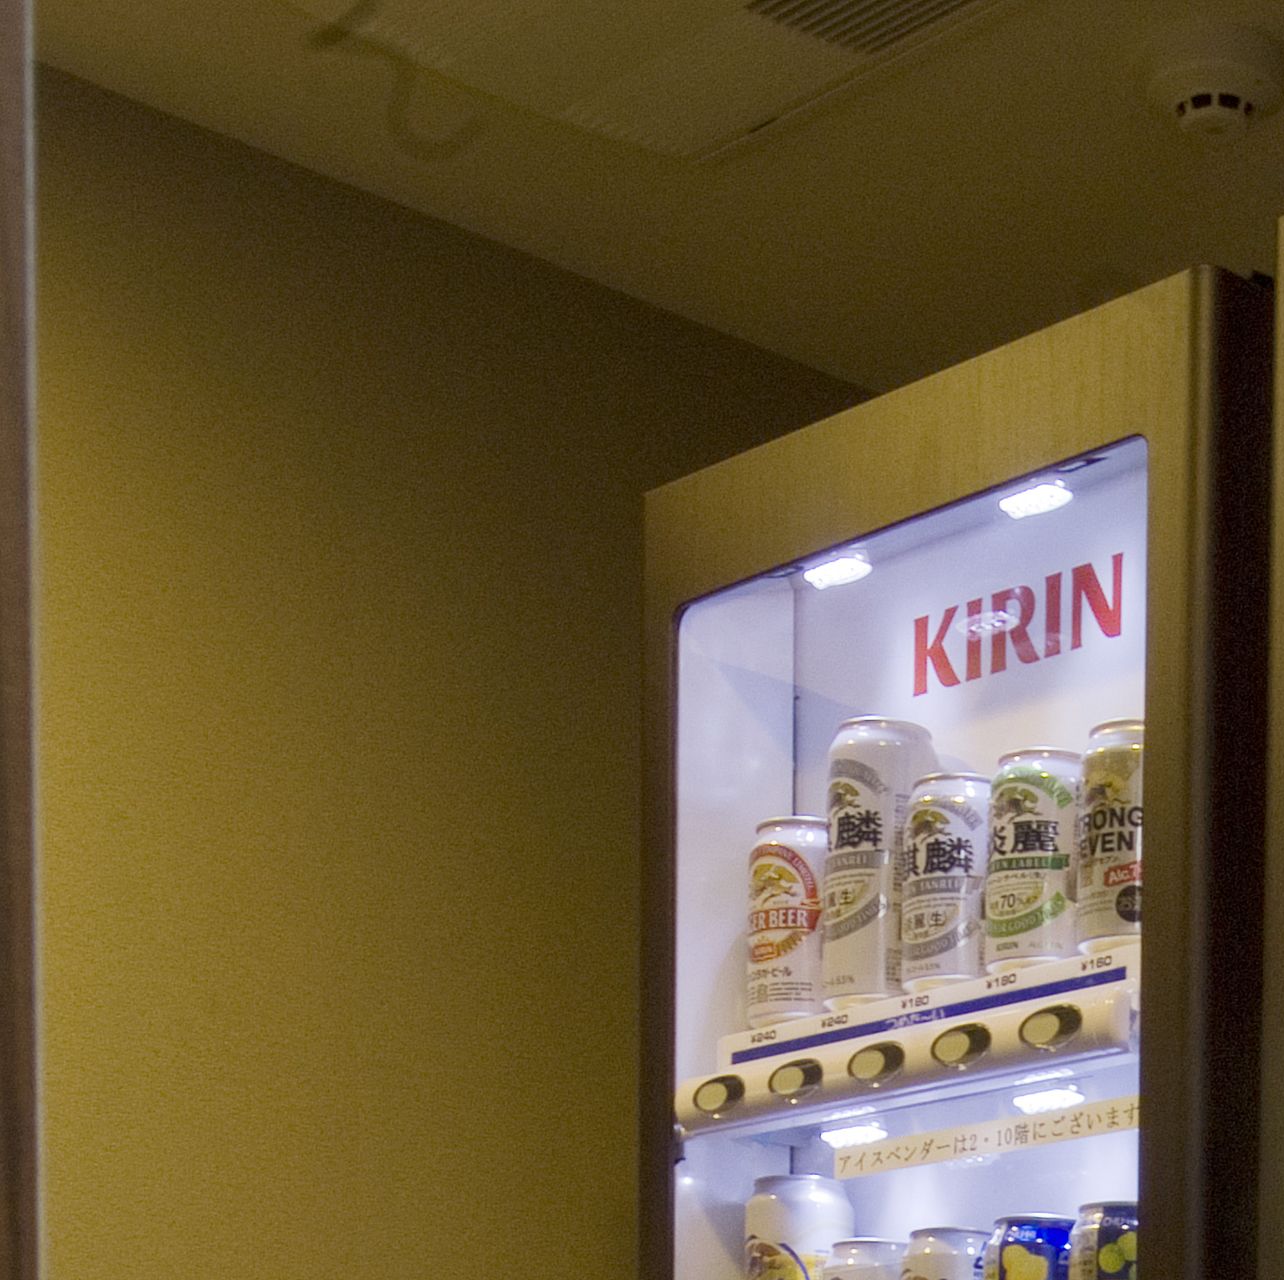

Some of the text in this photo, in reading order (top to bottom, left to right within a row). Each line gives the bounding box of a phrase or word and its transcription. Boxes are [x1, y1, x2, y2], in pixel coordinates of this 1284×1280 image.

[913, 552, 1124, 697] KIRIN
[1081, 806, 1143, 832] RONG
[1079, 830, 1134, 858] EVEN
[769, 909, 808, 929] BEER
